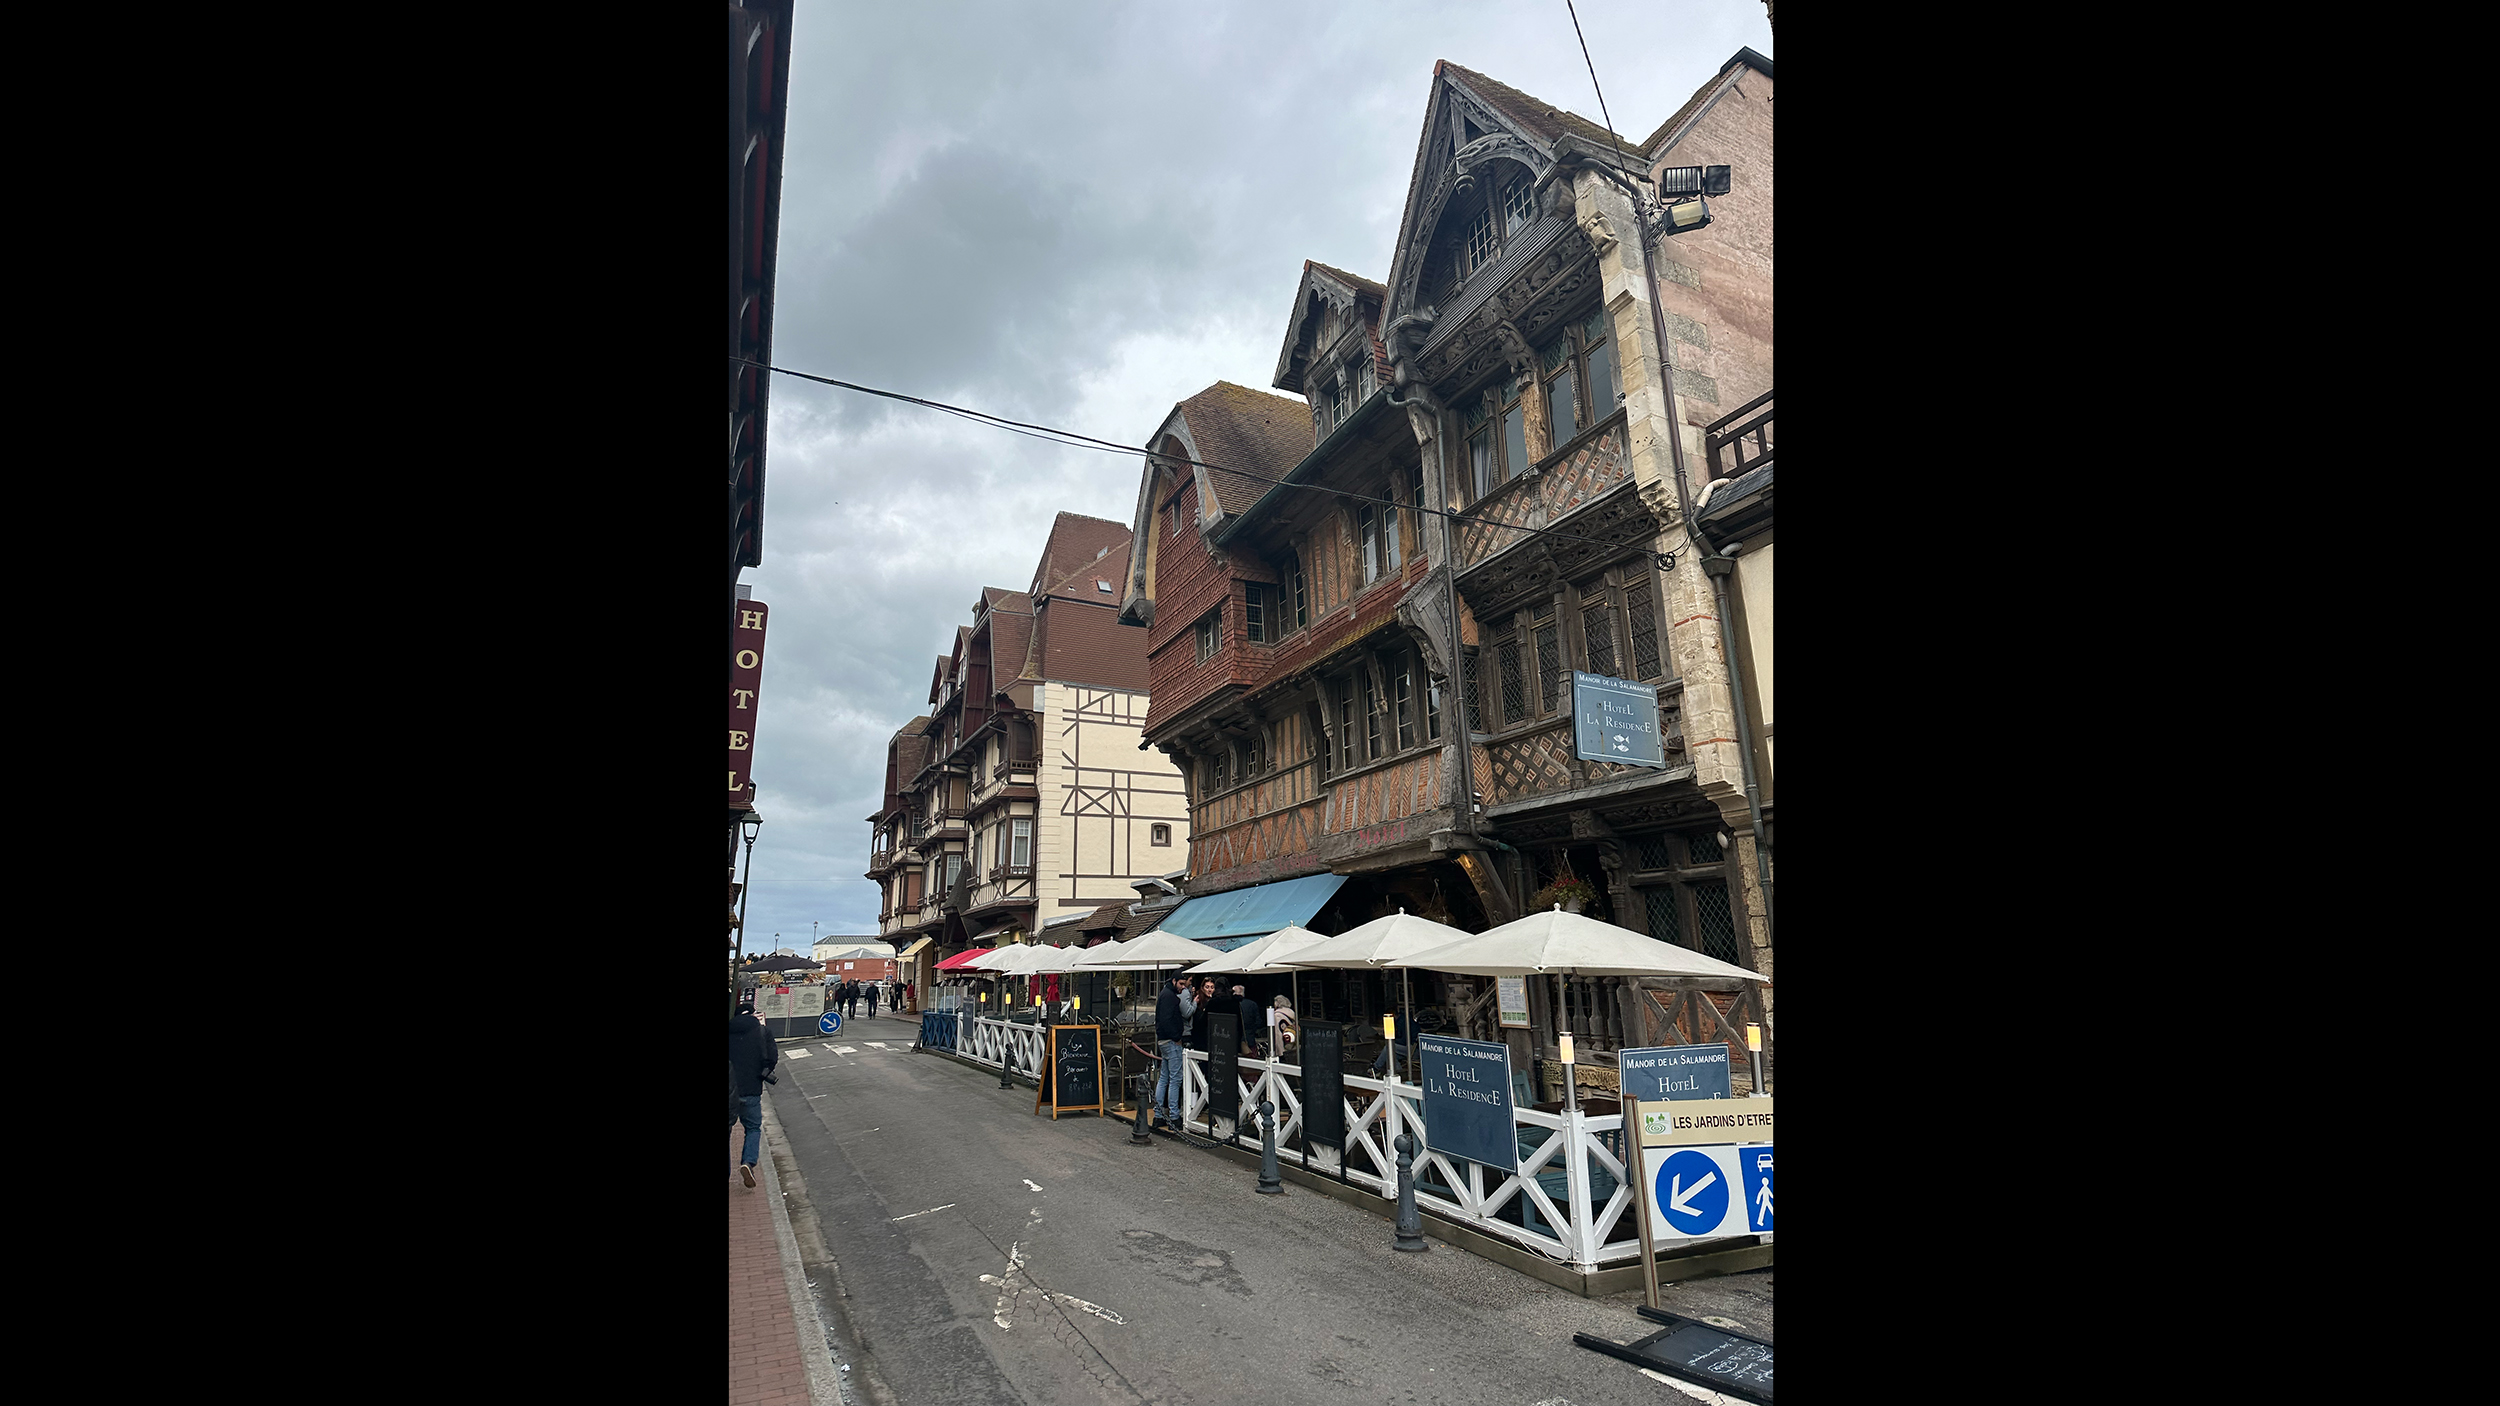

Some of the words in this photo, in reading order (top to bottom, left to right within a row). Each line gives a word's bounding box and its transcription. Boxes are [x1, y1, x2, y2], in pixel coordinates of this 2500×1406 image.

[1578, 674, 1601, 684] MANOIR
[1619, 681, 1653, 694] SALAMANDRE
[729, 609, 764, 792] HOTEL
[1586, 713, 1600, 725] LA
[1605, 715, 1652, 733] RESIDENCE
[1421, 1041, 1444, 1054] MANOIR
[1444, 1046, 1453, 1055] DE
[1453, 1047, 1462, 1056] LA
[1462, 1047, 1504, 1062] SALAMANDRE
[1626, 1058, 1656, 1069] MANOIR
[1658, 1058, 1668, 1067] DE
[1668, 1057, 1679, 1066] LA
[1680, 1053, 1726, 1066] SALAMANDRE
[1445, 1063, 1480, 1083] HOTEL
[1429, 1078, 1444, 1095] LA
[1448, 1081, 1502, 1106] RESIDENCE
[1658, 1074, 1700, 1094] HOTEL
[1672, 1116, 1692, 1129] LES
[1694, 1114, 1736, 1129] JARDINS
[1737, 1113, 1773, 1127] D'ETRE
